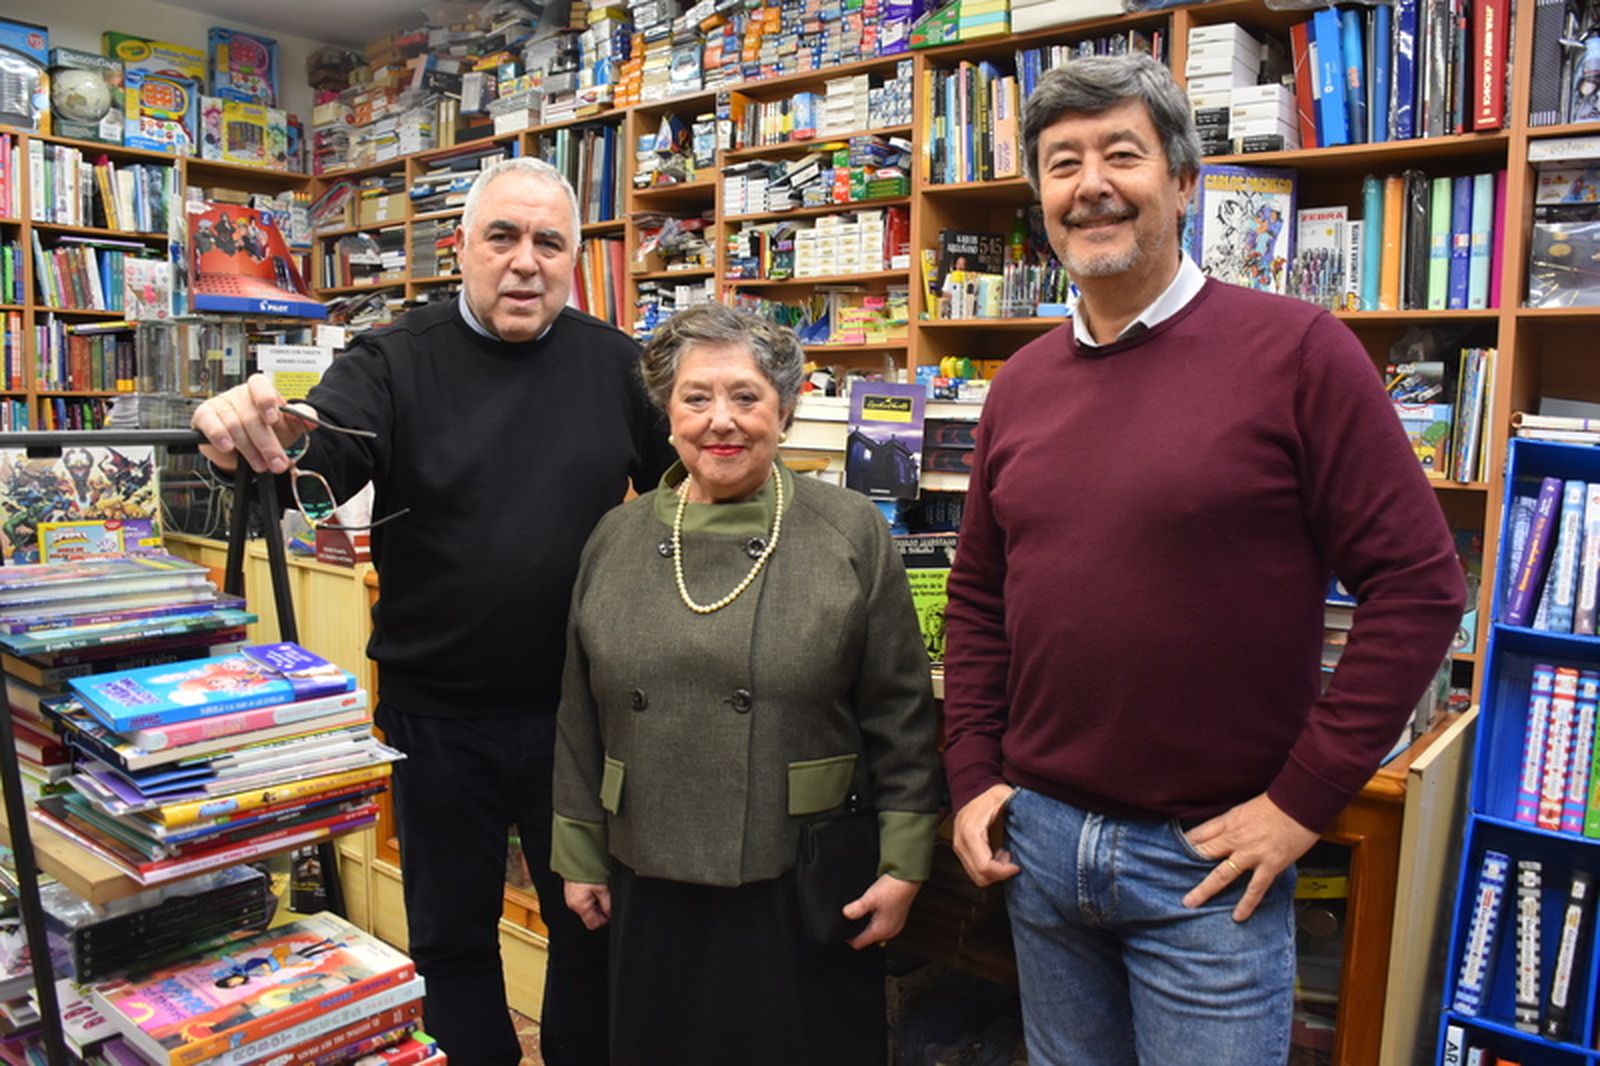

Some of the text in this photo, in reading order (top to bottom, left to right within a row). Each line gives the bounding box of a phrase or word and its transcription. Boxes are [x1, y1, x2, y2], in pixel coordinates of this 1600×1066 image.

[1204, 174, 1293, 194] CARLOS PACHECO
[1301, 212, 1344, 222] ZEBRA
[267, 303, 289, 313] PILOT
